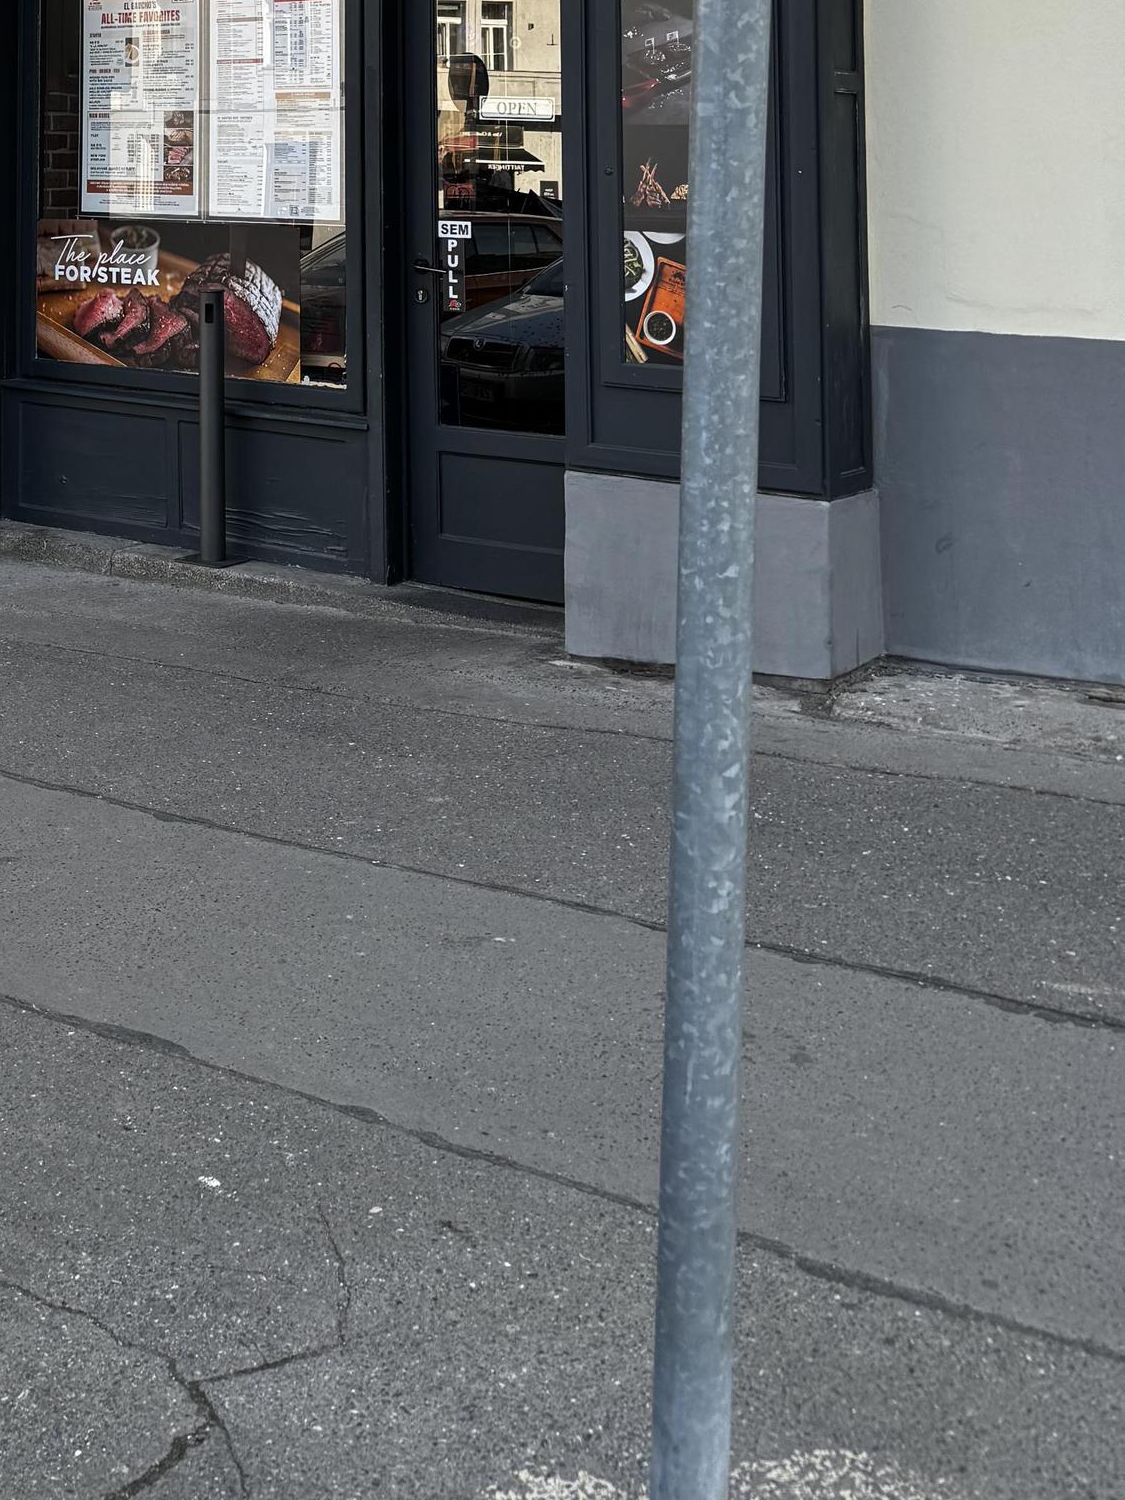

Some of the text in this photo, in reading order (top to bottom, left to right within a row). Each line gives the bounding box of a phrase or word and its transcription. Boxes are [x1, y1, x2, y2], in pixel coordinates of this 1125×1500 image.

[497, 102, 537, 116] OPEN
[440, 223, 469, 235] SEM
[50, 234, 152, 278] The place
[54, 264, 161, 287] FOR STEAK
[447, 239, 459, 299] PULL
